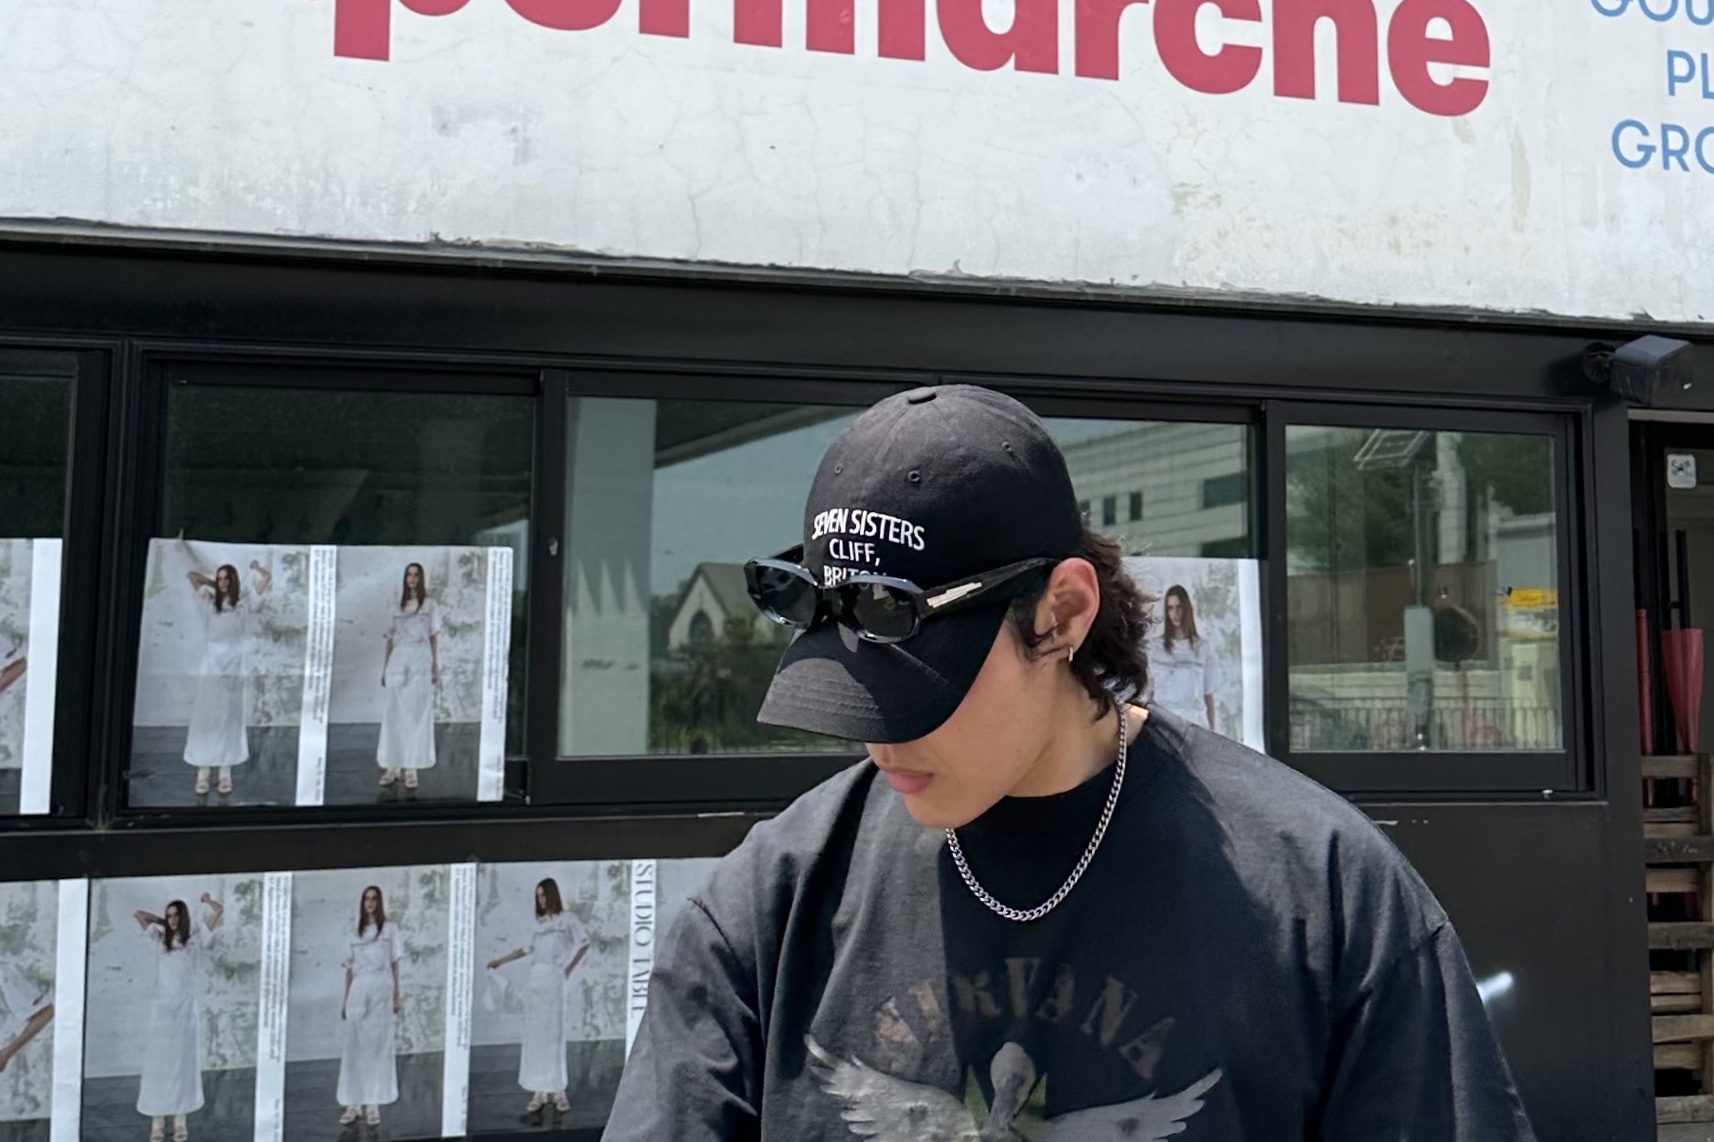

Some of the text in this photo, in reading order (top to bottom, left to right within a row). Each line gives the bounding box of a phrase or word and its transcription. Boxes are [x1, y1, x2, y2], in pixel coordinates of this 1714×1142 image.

[812, 508, 925, 551] SEVEN SISTERS
[829, 538, 881, 567] CLIFF,
[634, 863, 654, 947] STUDIO
